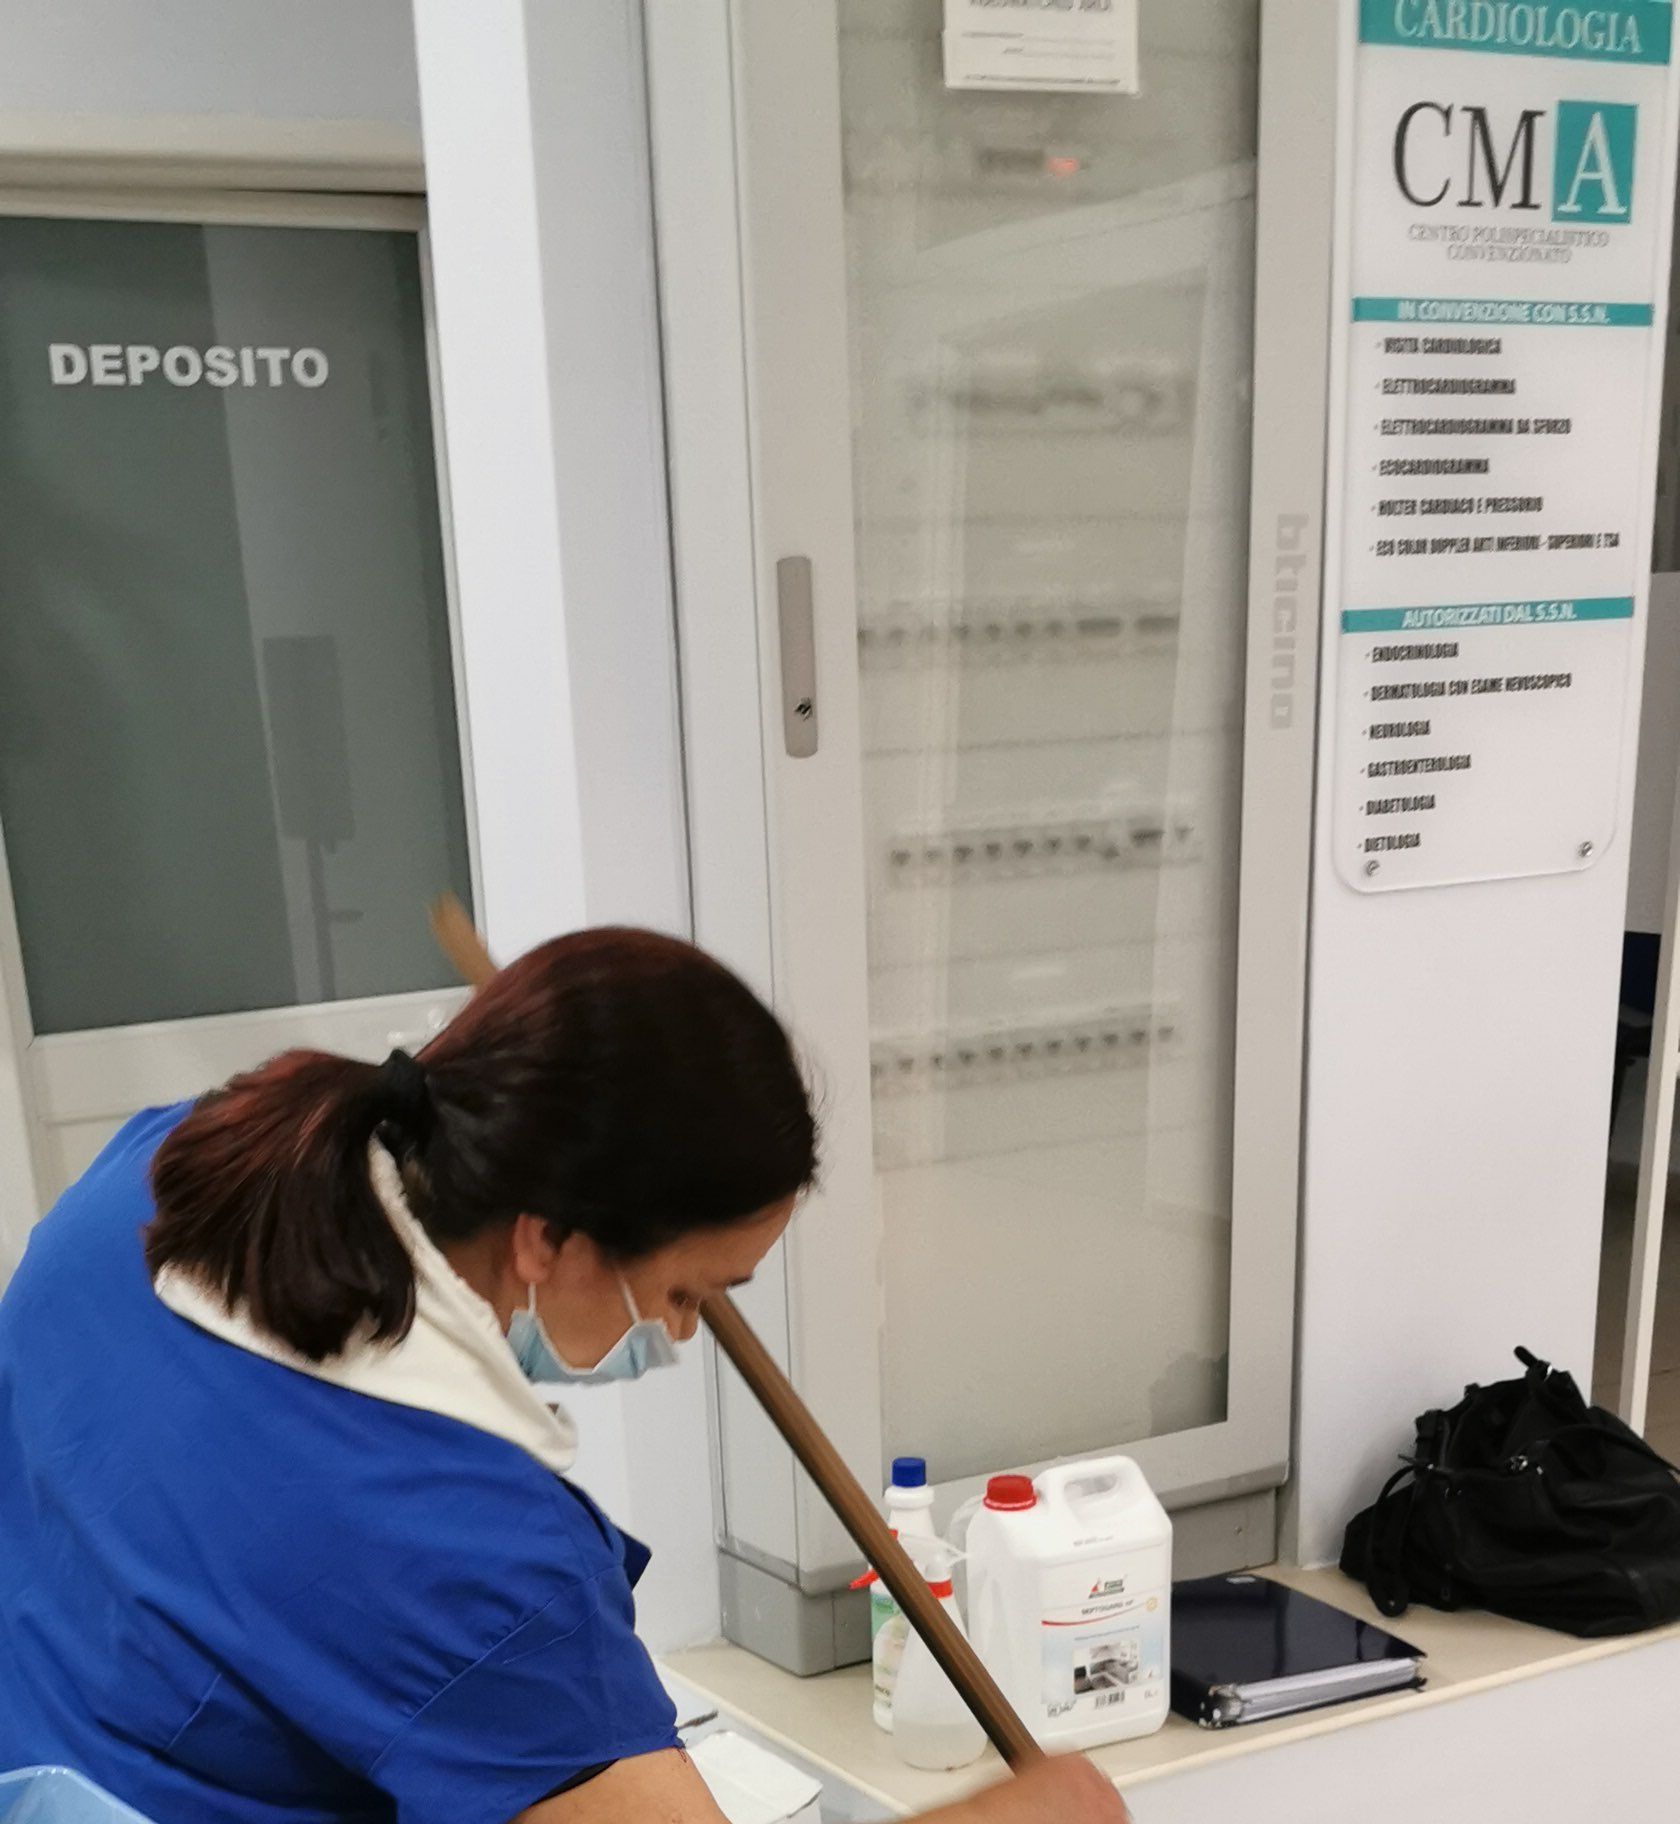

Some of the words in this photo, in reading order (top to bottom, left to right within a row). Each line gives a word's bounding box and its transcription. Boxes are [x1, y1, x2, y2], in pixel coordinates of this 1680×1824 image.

[1394, 0, 1642, 53] CARDIOLOGIA
[1394, 101, 1627, 214] CMA
[1409, 223, 1469, 242] CENTRO
[1448, 244, 1572, 263] CONVENZIONATO
[1398, 301, 1416, 321] IN
[1419, 301, 1531, 322] CONVENZIONE
[1533, 303, 1566, 322] CON
[1567, 303, 1610, 323] S.S.N.
[1385, 337, 1418, 354] VISITA
[1422, 337, 1502, 355] CARDIOLOGICA
[49, 343, 329, 387] DEPOSITO
[1382, 378, 1516, 395] ELETTROCARDIOGRAMMA
[1381, 418, 1513, 435] ELETTROCARDIOGRAMMA
[1533, 418, 1571, 434] SFORZO
[1379, 458, 1489, 476] ECOCARDIOGRAMMA
[1378, 499, 1417, 516] HOLTER
[1420, 498, 1474, 515] CARDIACO
[1430, 536, 1469, 555] DOPPLER
[1271, 513, 1309, 730] bticino
[1402, 606, 1500, 629] AUTORIZZATI
[1503, 604, 1533, 624] DAL
[1535, 601, 1577, 622] S.S.N.
[1372, 642, 1459, 663] ENDOCRINOLOGIA
[1371, 681, 1445, 701] DERMATOLOGIA
[1448, 679, 1468, 697] CON
[1471, 677, 1503, 695] ESAME
[1369, 719, 1430, 740] NEUROLOGIA
[1367, 754, 1471, 778] GASTROENTEROLOGIA
[1365, 794, 1436, 815] DIABETOLOGIA
[1364, 833, 1420, 853] DIETOLOGIA
